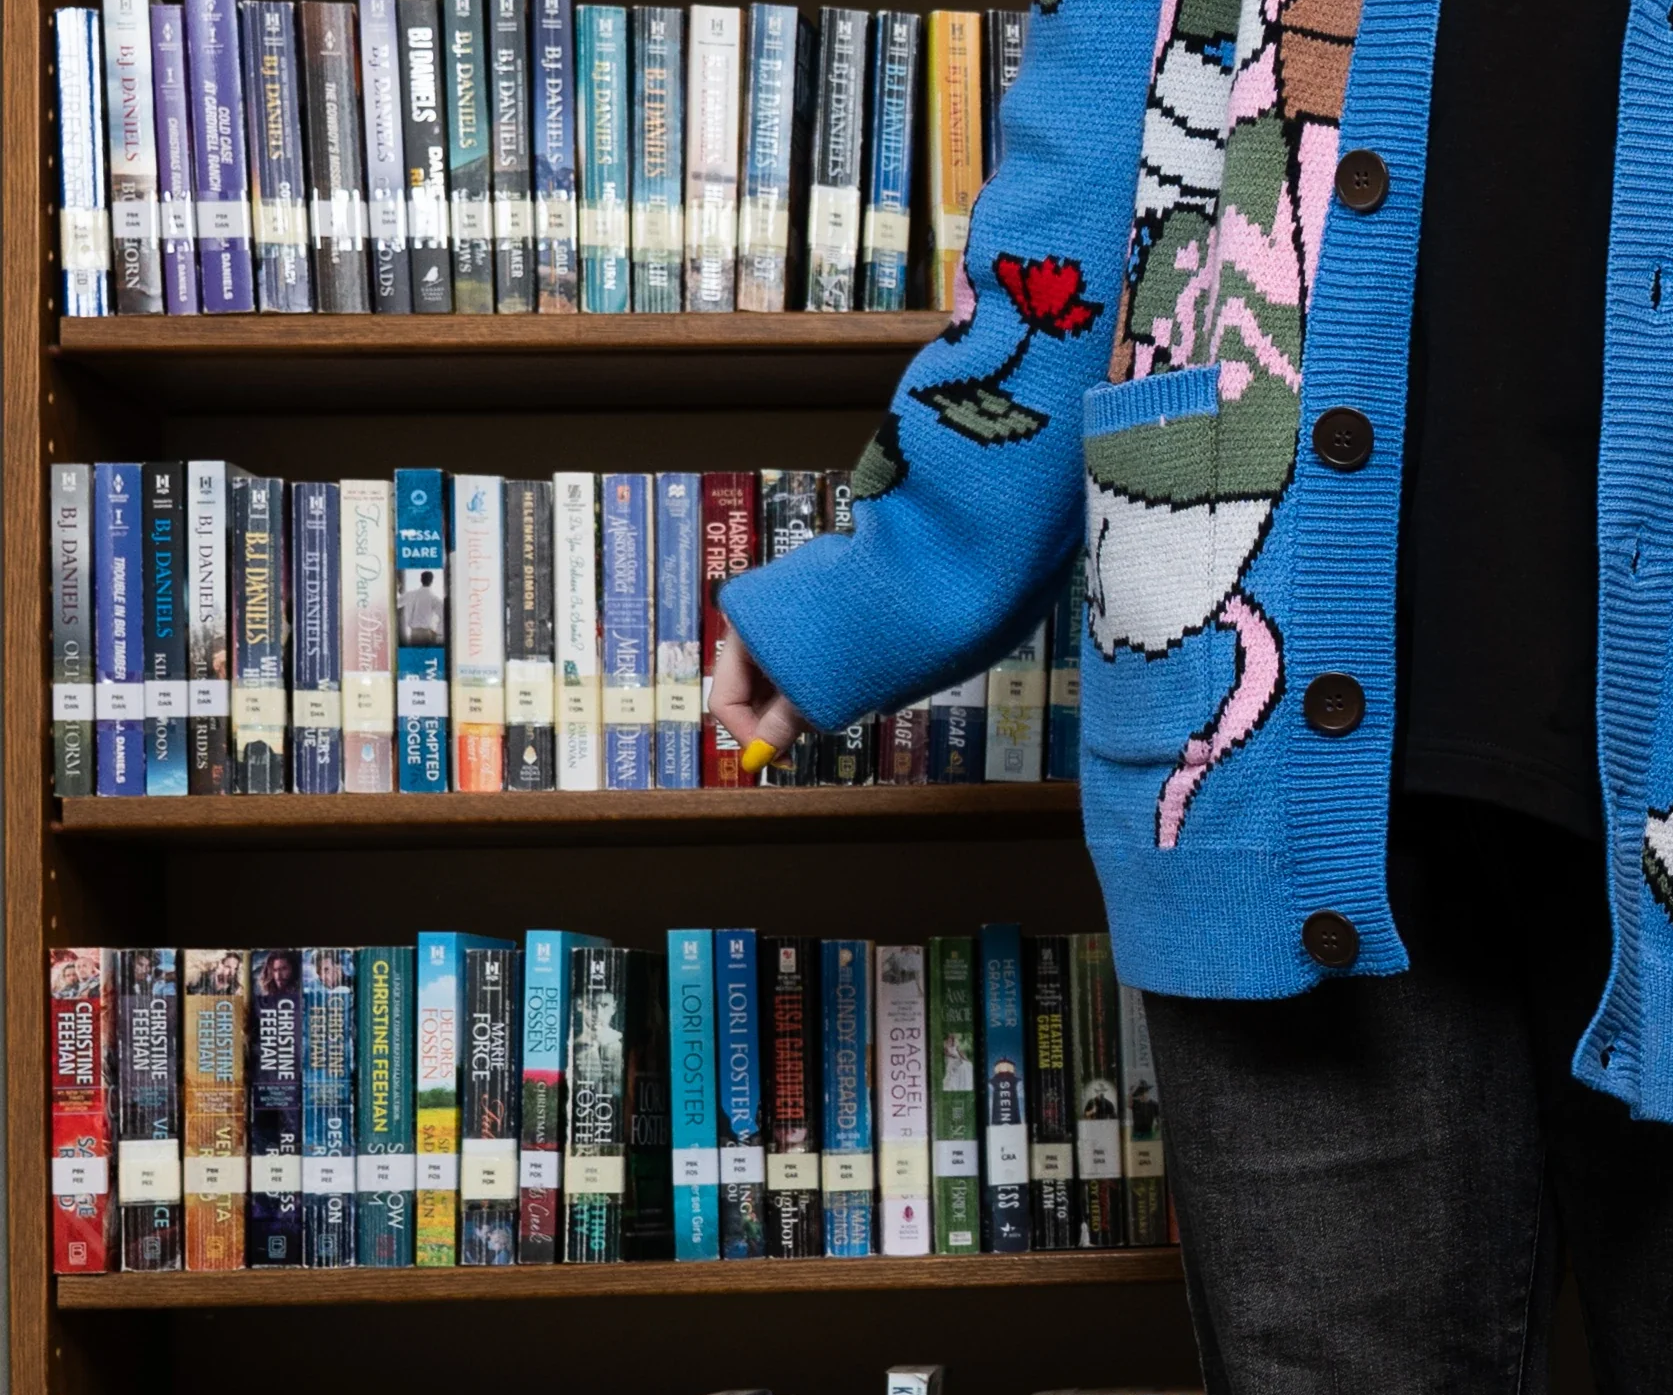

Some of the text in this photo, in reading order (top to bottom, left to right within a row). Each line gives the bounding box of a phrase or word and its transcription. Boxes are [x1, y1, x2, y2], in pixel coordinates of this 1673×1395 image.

[118, 46, 138, 161] B.J. DANIELS
[409, 28, 436, 122] BJ DANIELS
[542, 47, 563, 163] B.J. DANIELS
[204, 81, 221, 191] AT CARDWELL RANCH
[219, 107, 232, 164] COLD CASE
[154, 518, 173, 638] B.J. DANIELS
[196, 515, 213, 623] B.J. DANIELS
[464, 529, 491, 657] Jude Deveraux
[707, 523, 725, 579] OF FIRE
[114, 557, 126, 679] TROUBLE IN BIG TIMBER
[59, 1012, 75, 1075] FEEHAN
[76, 1002, 93, 1083] CHRISTINE
[373, 961, 388, 1132] CHRISTINE FEEHAN
[422, 1008, 439, 1079] FOSSEN
[440, 1009, 454, 1078] DELORES
[473, 1013, 491, 1081] FORCE
[491, 1023, 504, 1070] MARIE
[682, 985, 704, 1126] LORI FOSTER
[890, 1028, 906, 1117] GIBSON
[906, 1027, 921, 1116] RACHEL
